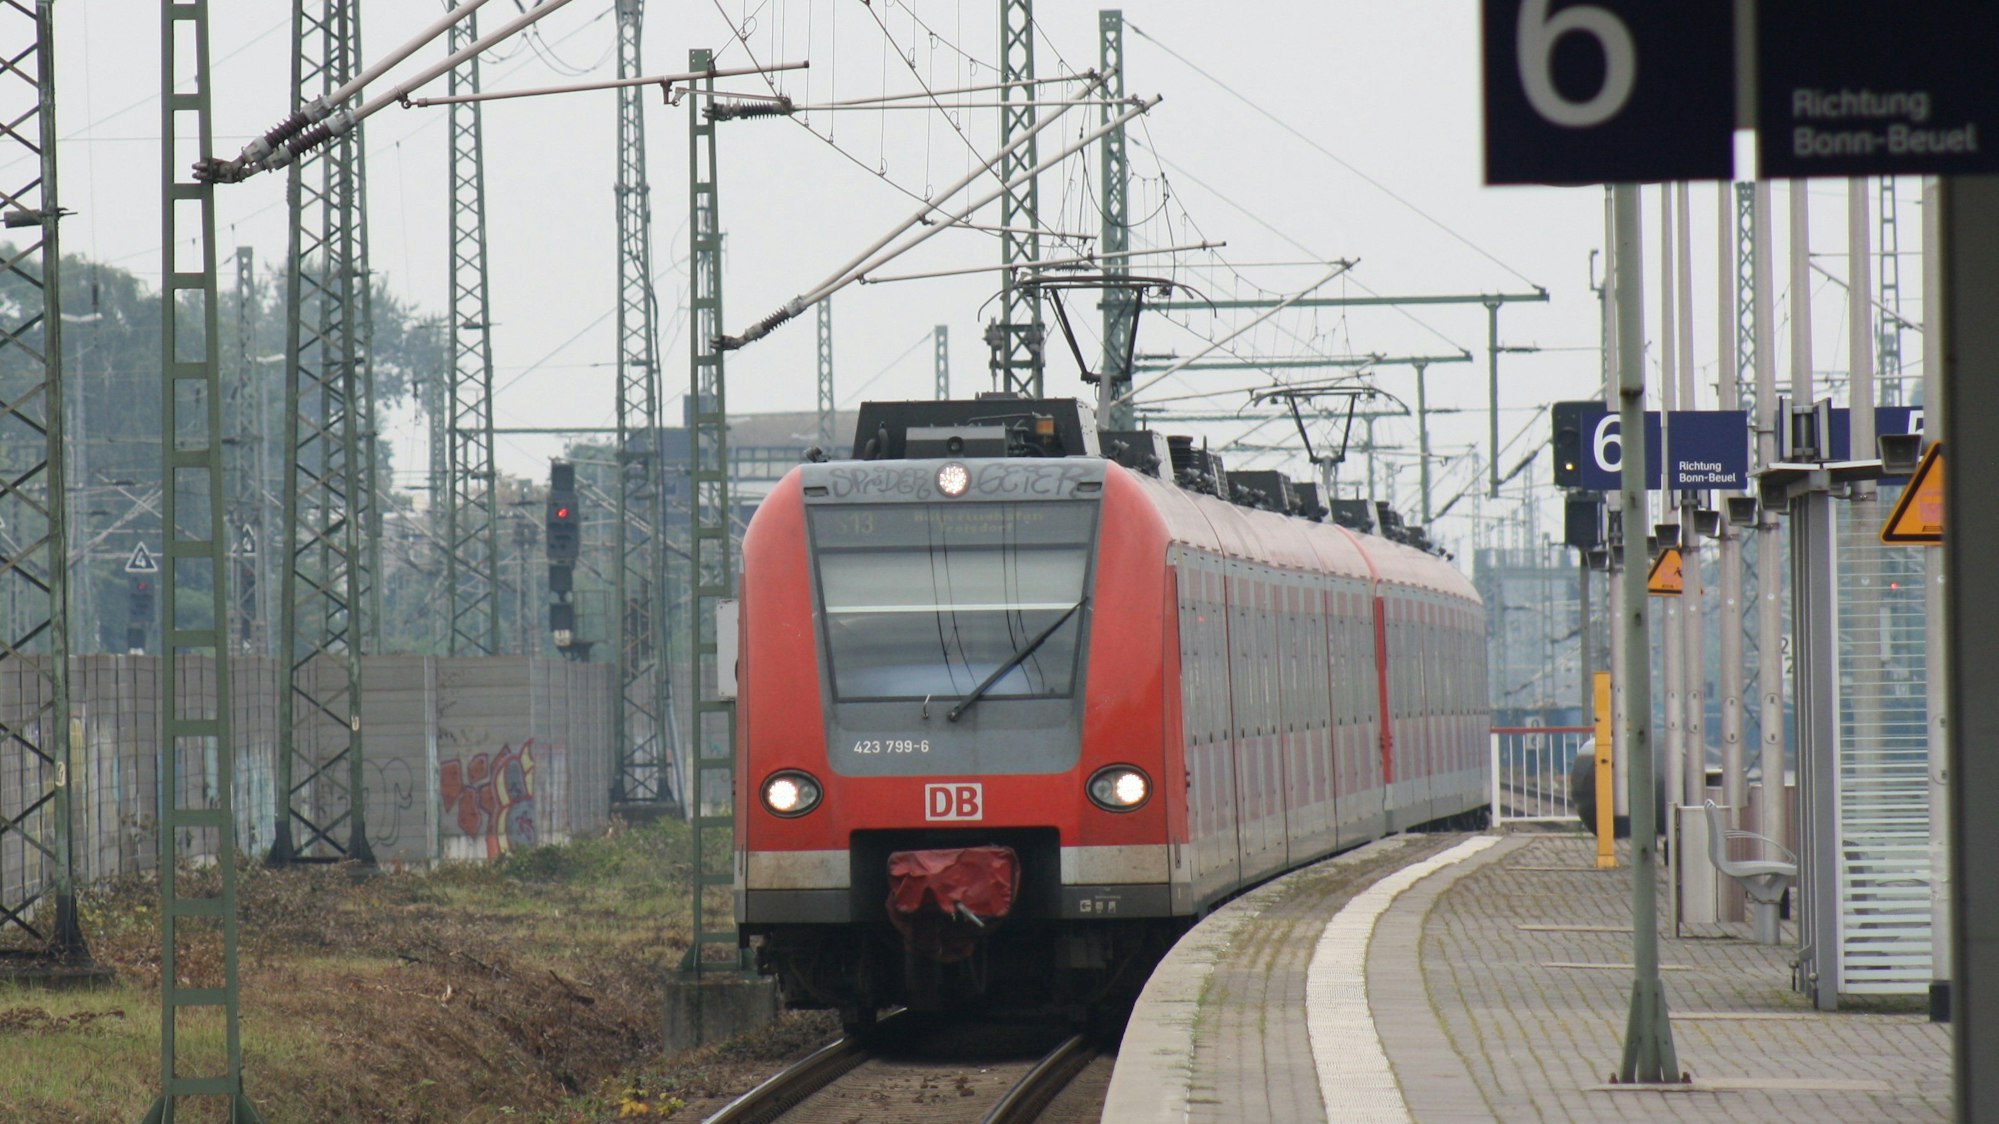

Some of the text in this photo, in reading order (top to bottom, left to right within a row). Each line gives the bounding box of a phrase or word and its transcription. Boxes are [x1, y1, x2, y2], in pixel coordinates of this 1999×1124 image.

[1517, 0, 1637, 128] 6
[1793, 88, 1929, 120] Richtung
[1793, 123, 1977, 156] Bonn-Beuel
[1593, 413, 1622, 473] 6
[1679, 461, 1722, 473] Richtung
[1679, 472, 1737, 484] Bonn-Beuel
[853, 739, 930, 754] 423 799-6
[929, 785, 979, 818] DB
